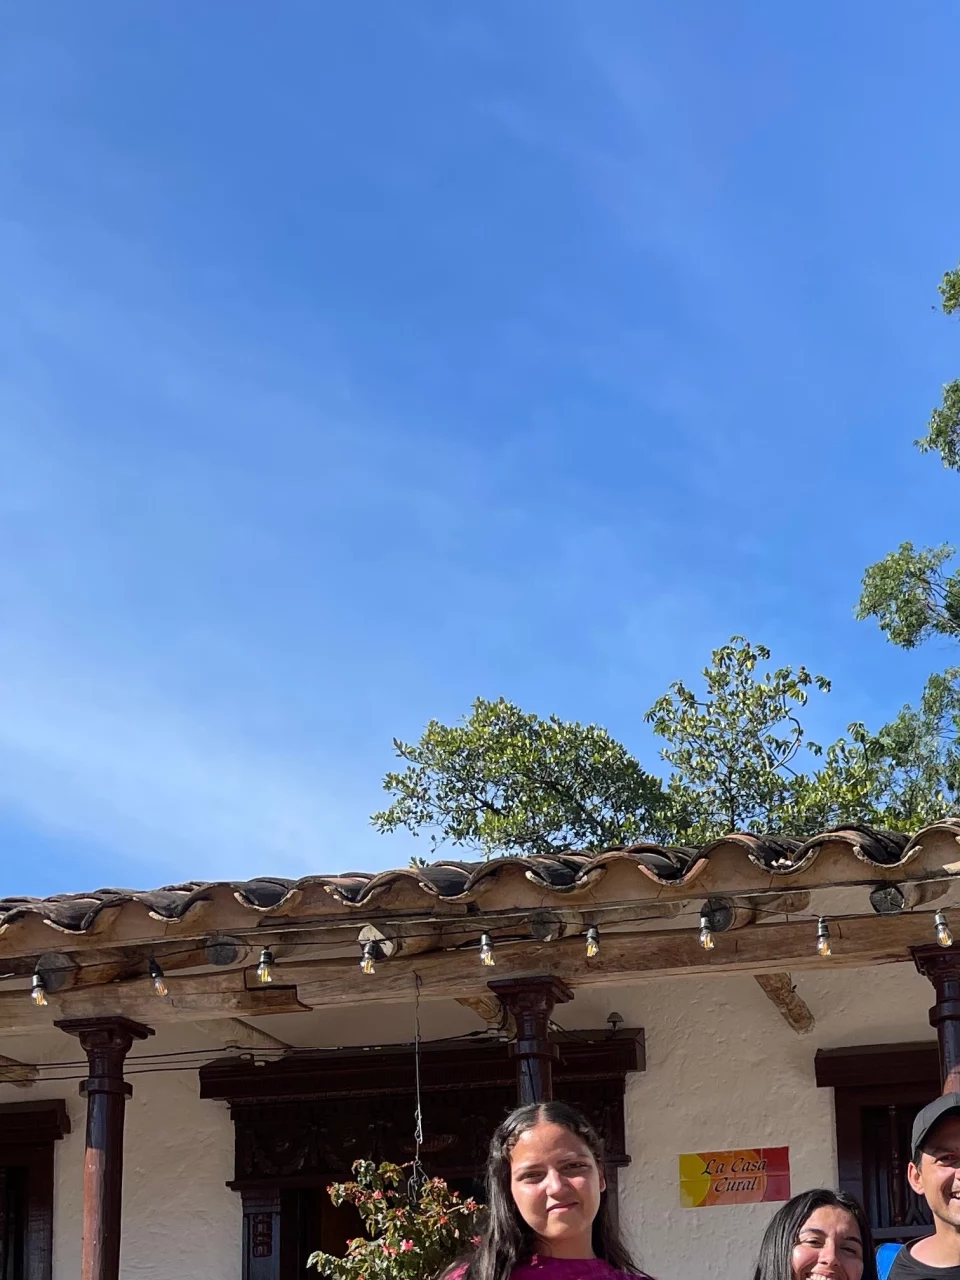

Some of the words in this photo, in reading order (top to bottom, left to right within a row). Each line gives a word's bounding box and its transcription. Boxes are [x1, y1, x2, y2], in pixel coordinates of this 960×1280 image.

[701, 1159, 725, 1176] La
[731, 1158, 767, 1173] Casa
[714, 1177, 758, 1193] Cural
